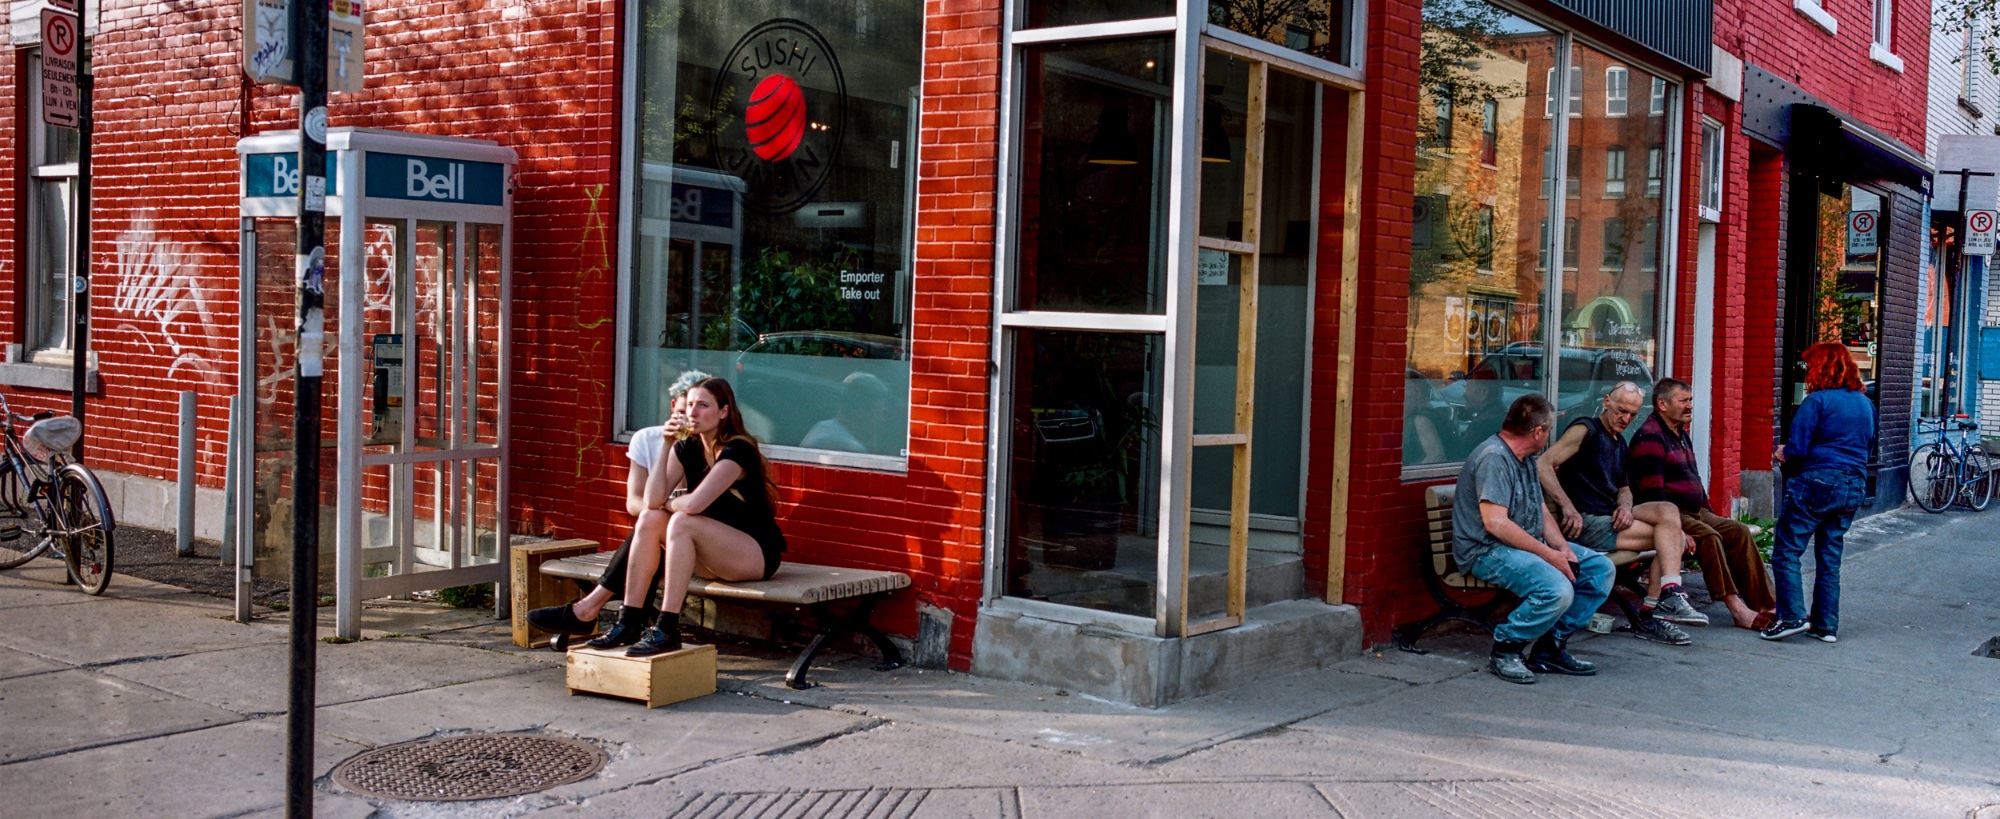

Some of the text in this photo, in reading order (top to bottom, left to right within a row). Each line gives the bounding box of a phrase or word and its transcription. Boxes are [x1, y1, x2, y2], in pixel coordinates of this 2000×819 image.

[45, 57, 76, 71] LIVRAISON
[741, 37, 817, 82] SUSHI
[44, 70, 78, 83] SEULEMENT
[63, 86, 72, 97] 12h
[45, 95, 57, 106] LUN
[66, 100, 77, 110] VEN
[274, 156, 299, 194] Be
[407, 159, 464, 200] Bell
[840, 270, 885, 285] Emporter
[840, 287, 880, 300] Take out
